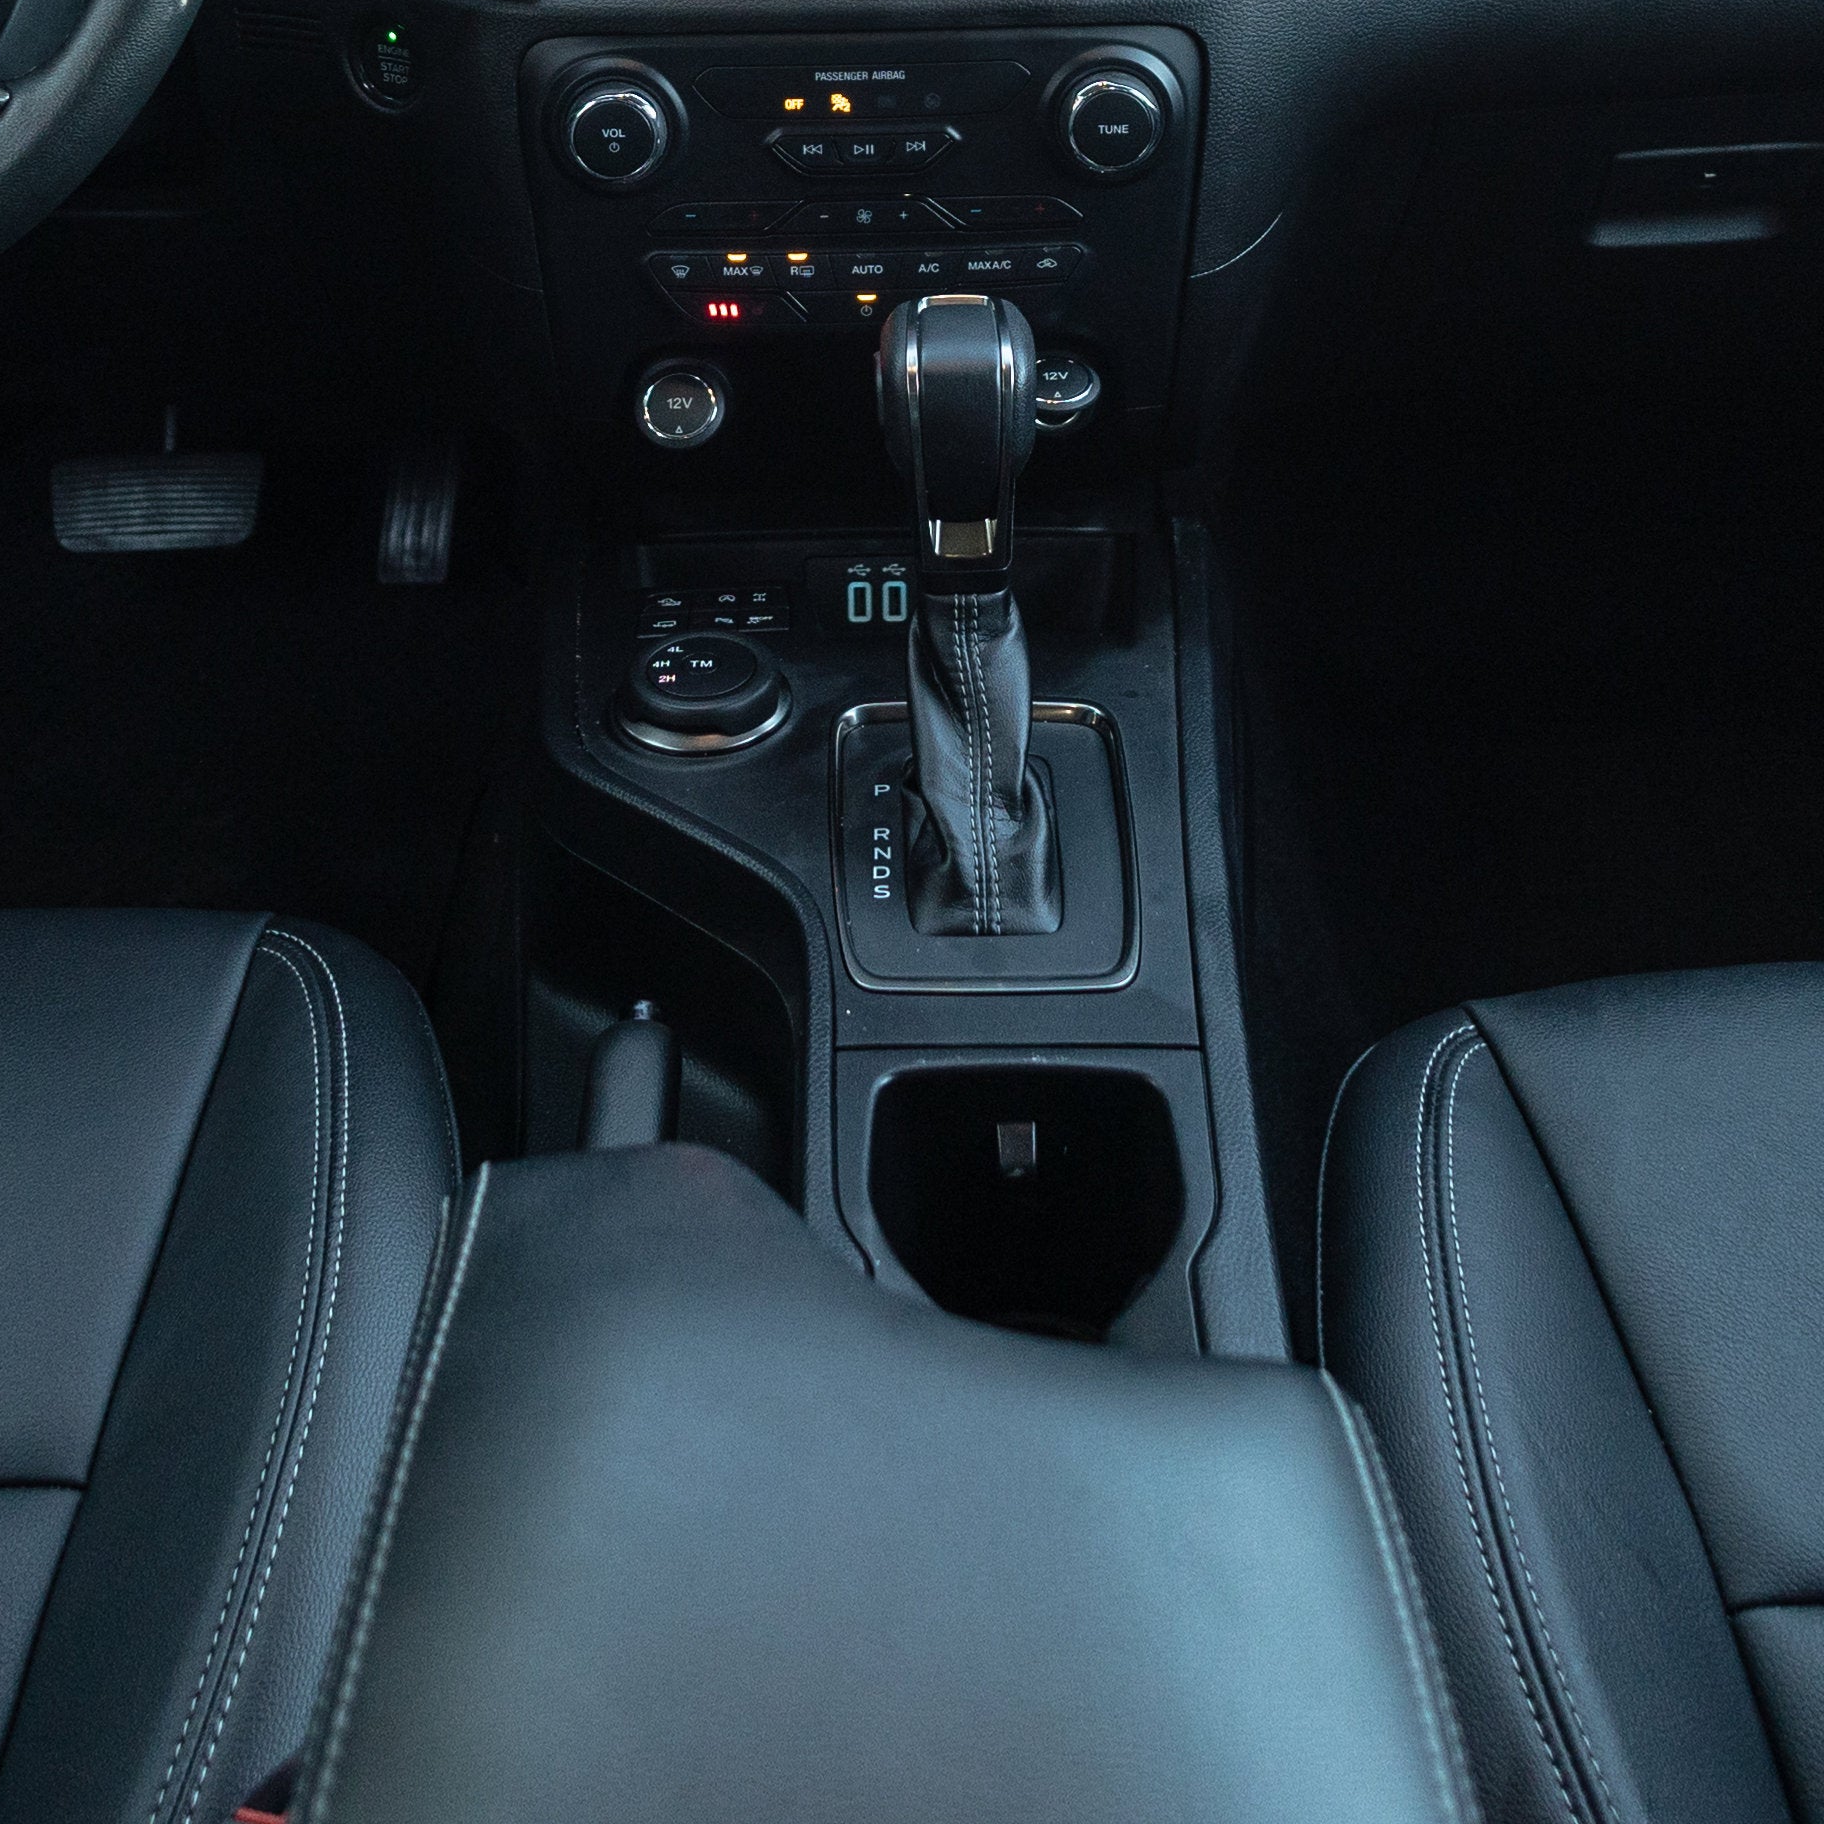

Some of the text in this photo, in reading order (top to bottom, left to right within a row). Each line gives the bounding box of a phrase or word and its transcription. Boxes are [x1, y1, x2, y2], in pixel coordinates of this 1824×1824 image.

[380, 61, 410, 76] START
[383, 72, 408, 86] STOP
[814, 70, 906, 81] PASSENGER AIRBAG
[784, 98, 805, 111] OFF
[601, 128, 626, 139] VOL
[1098, 123, 1130, 135] TUNE
[723, 266, 749, 276] MAX
[852, 265, 883, 275] AUTO
[918, 263, 940, 274] A/C
[1042, 371, 1069, 382] 12V
[666, 396, 693, 410] 12V
[652, 660, 671, 668] 4H
[689, 659, 713, 668] TM
[658, 674, 676, 683] 2H
[874, 784, 890, 796] P
[874, 828, 890, 840] R
[874, 847, 890, 860] N
[873, 866, 890, 879] D
[873, 885, 891, 899] S
